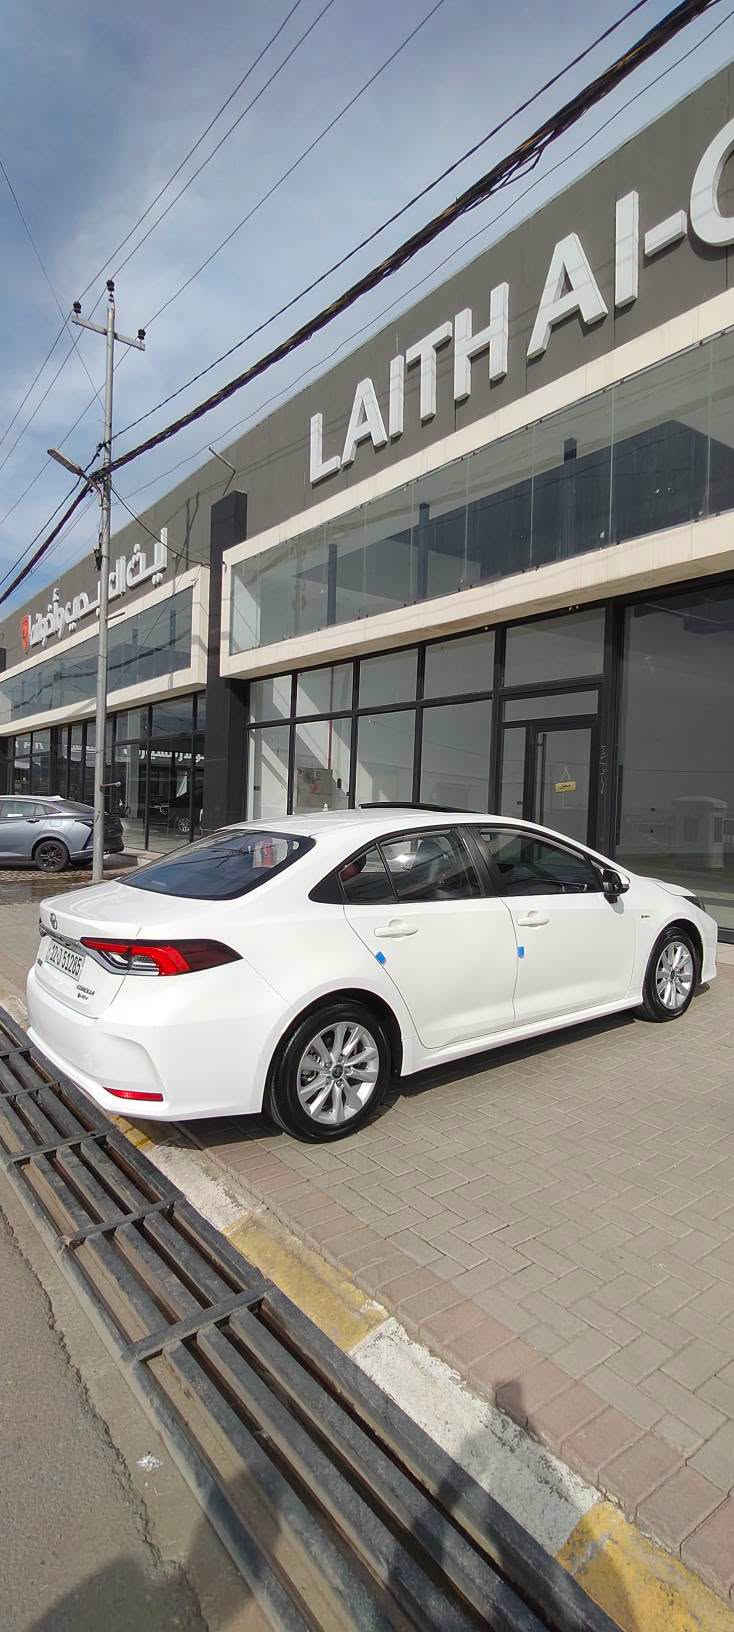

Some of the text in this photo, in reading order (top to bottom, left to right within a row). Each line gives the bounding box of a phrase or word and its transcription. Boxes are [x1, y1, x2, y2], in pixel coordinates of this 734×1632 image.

[309, 281, 510, 486] LAITH
[64, 554, 127, 632] العيدي
[126, 527, 169, 586] ليث
